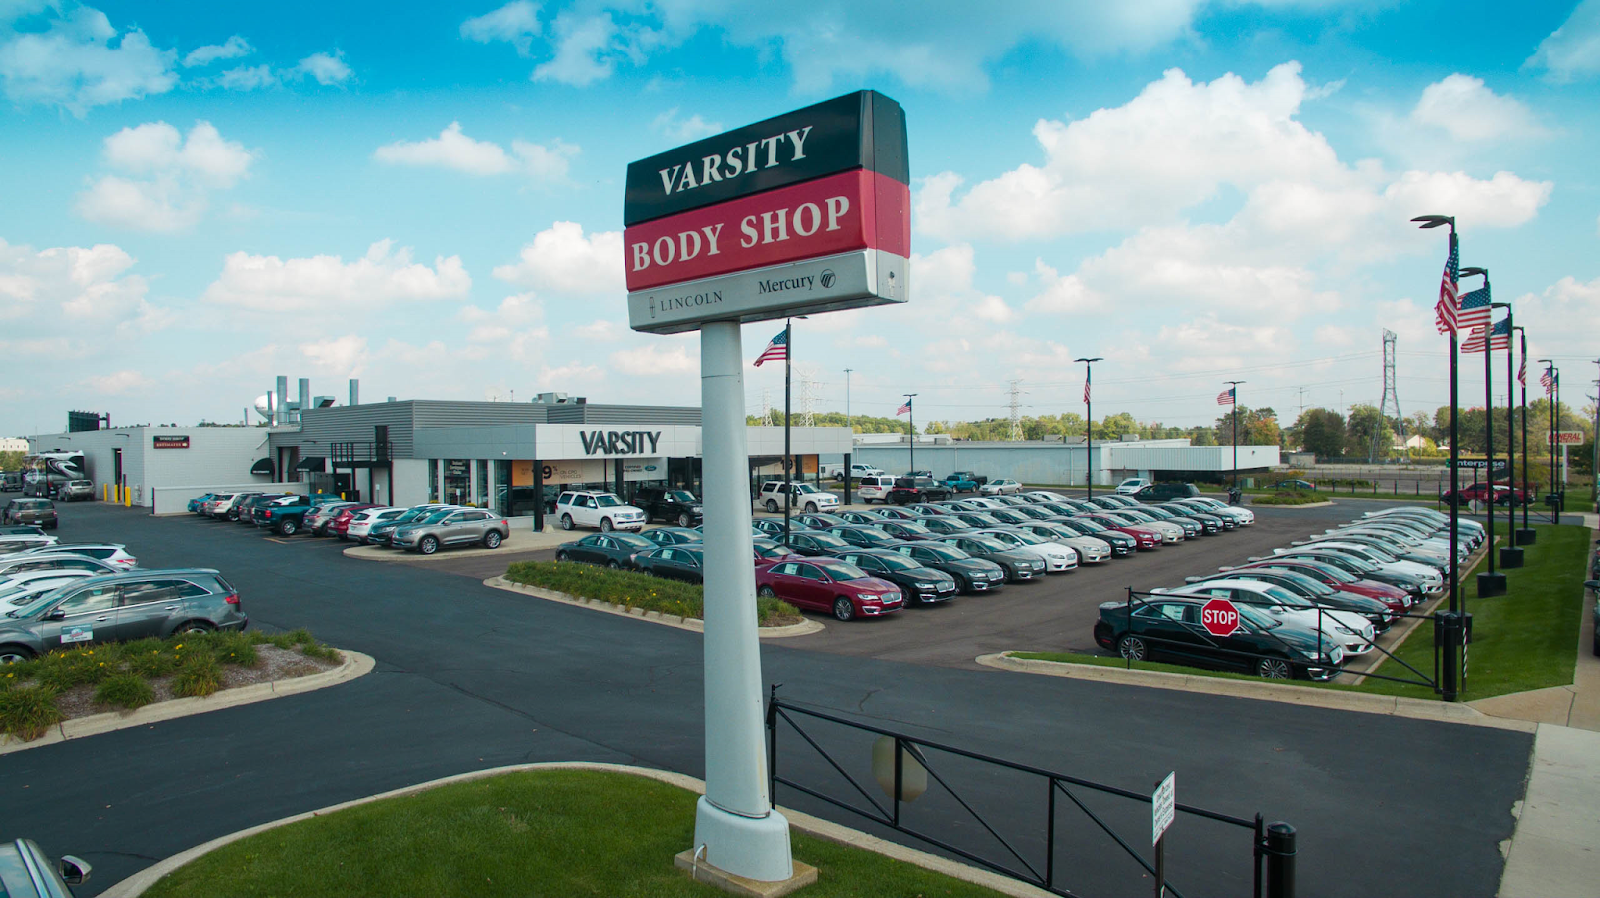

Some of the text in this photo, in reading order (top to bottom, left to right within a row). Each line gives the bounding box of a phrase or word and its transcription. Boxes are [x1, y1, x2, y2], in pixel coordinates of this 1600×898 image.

[658, 125, 813, 195] VARSITY
[631, 195, 850, 272] BODY SHOP
[758, 275, 815, 294] Mercury
[660, 290, 723, 312] LINCOLN
[579, 430, 662, 455] VARSITY
[1203, 609, 1237, 625] STOP
